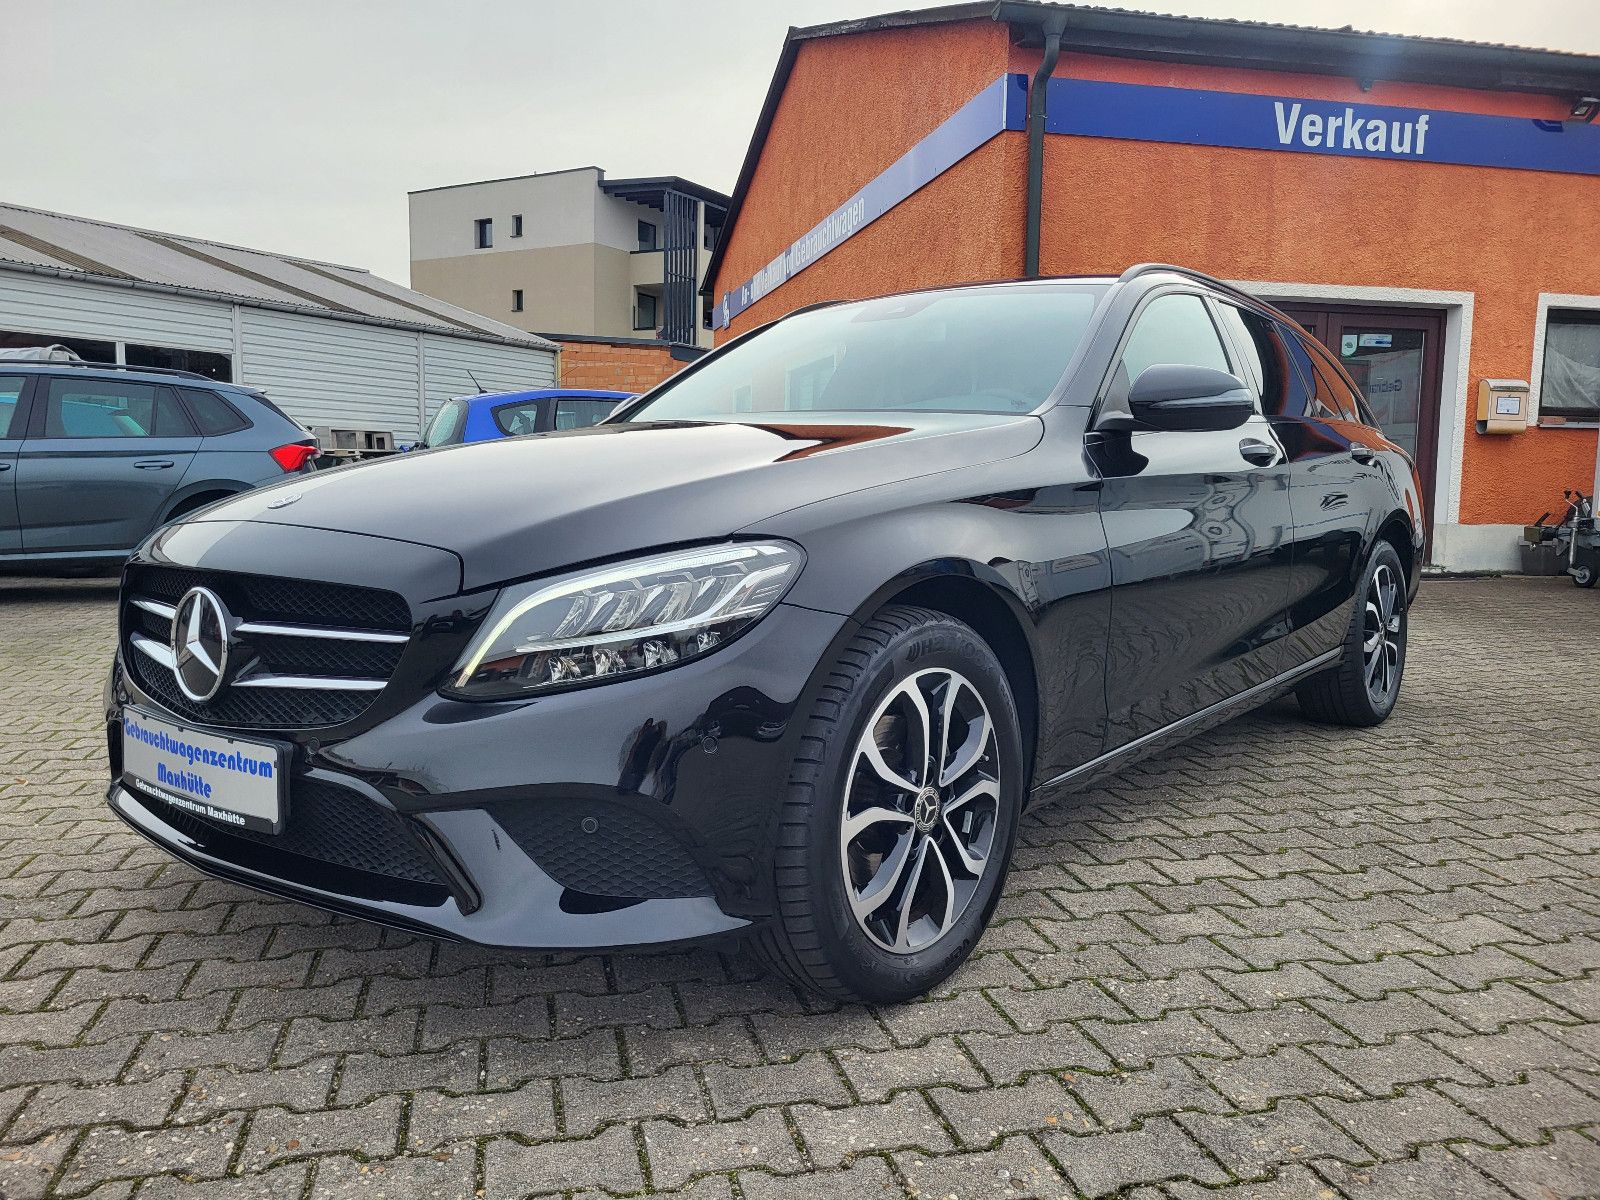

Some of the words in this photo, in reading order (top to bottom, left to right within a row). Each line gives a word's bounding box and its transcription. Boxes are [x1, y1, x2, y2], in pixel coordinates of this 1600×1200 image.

[1274, 101, 1430, 155] Verkauf
[795, 197, 865, 267] Gebrauchtwagen
[124, 716, 274, 779] Gebrauchtwagenzentrum
[135, 778, 207, 815] Gebrauchtwagenzentrum
[206, 805, 246, 827] Maxhütte
[157, 762, 212, 799] Maxhütte
